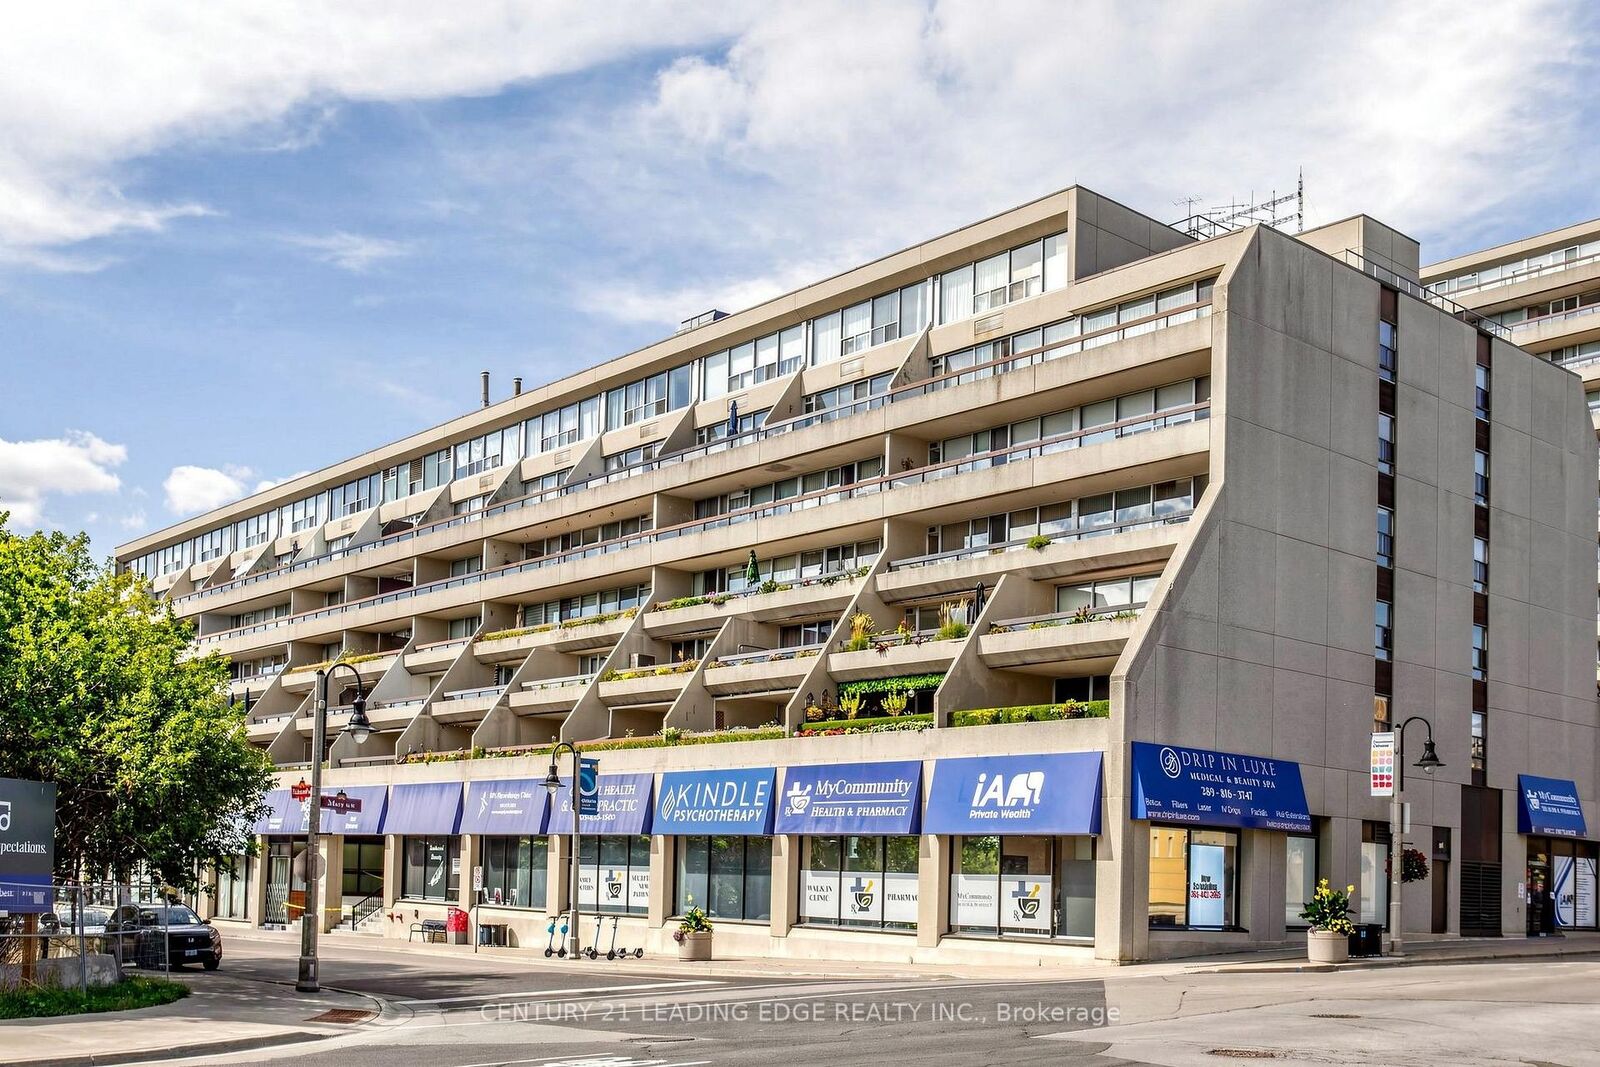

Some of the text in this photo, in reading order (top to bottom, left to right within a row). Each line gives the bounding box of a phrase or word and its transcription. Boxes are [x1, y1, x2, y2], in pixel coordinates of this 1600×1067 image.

[1181, 751, 1277, 776] DRIP IN LUXE
[1190, 772, 1224, 783] MEDICAL
[1234, 777, 1261, 787] BEAUTY
[1262, 780, 1276, 789] SPA
[604, 785, 636, 796] HEALTH
[676, 780, 768, 807] KINDLE
[815, 779, 913, 798] MyCommunity
[562, 800, 569, 812] &
[811, 806, 909, 817] HEALTH & PHARMACY
[673, 808, 763, 822] PSYCHOTHERAPY
[969, 810, 998, 819] Private
